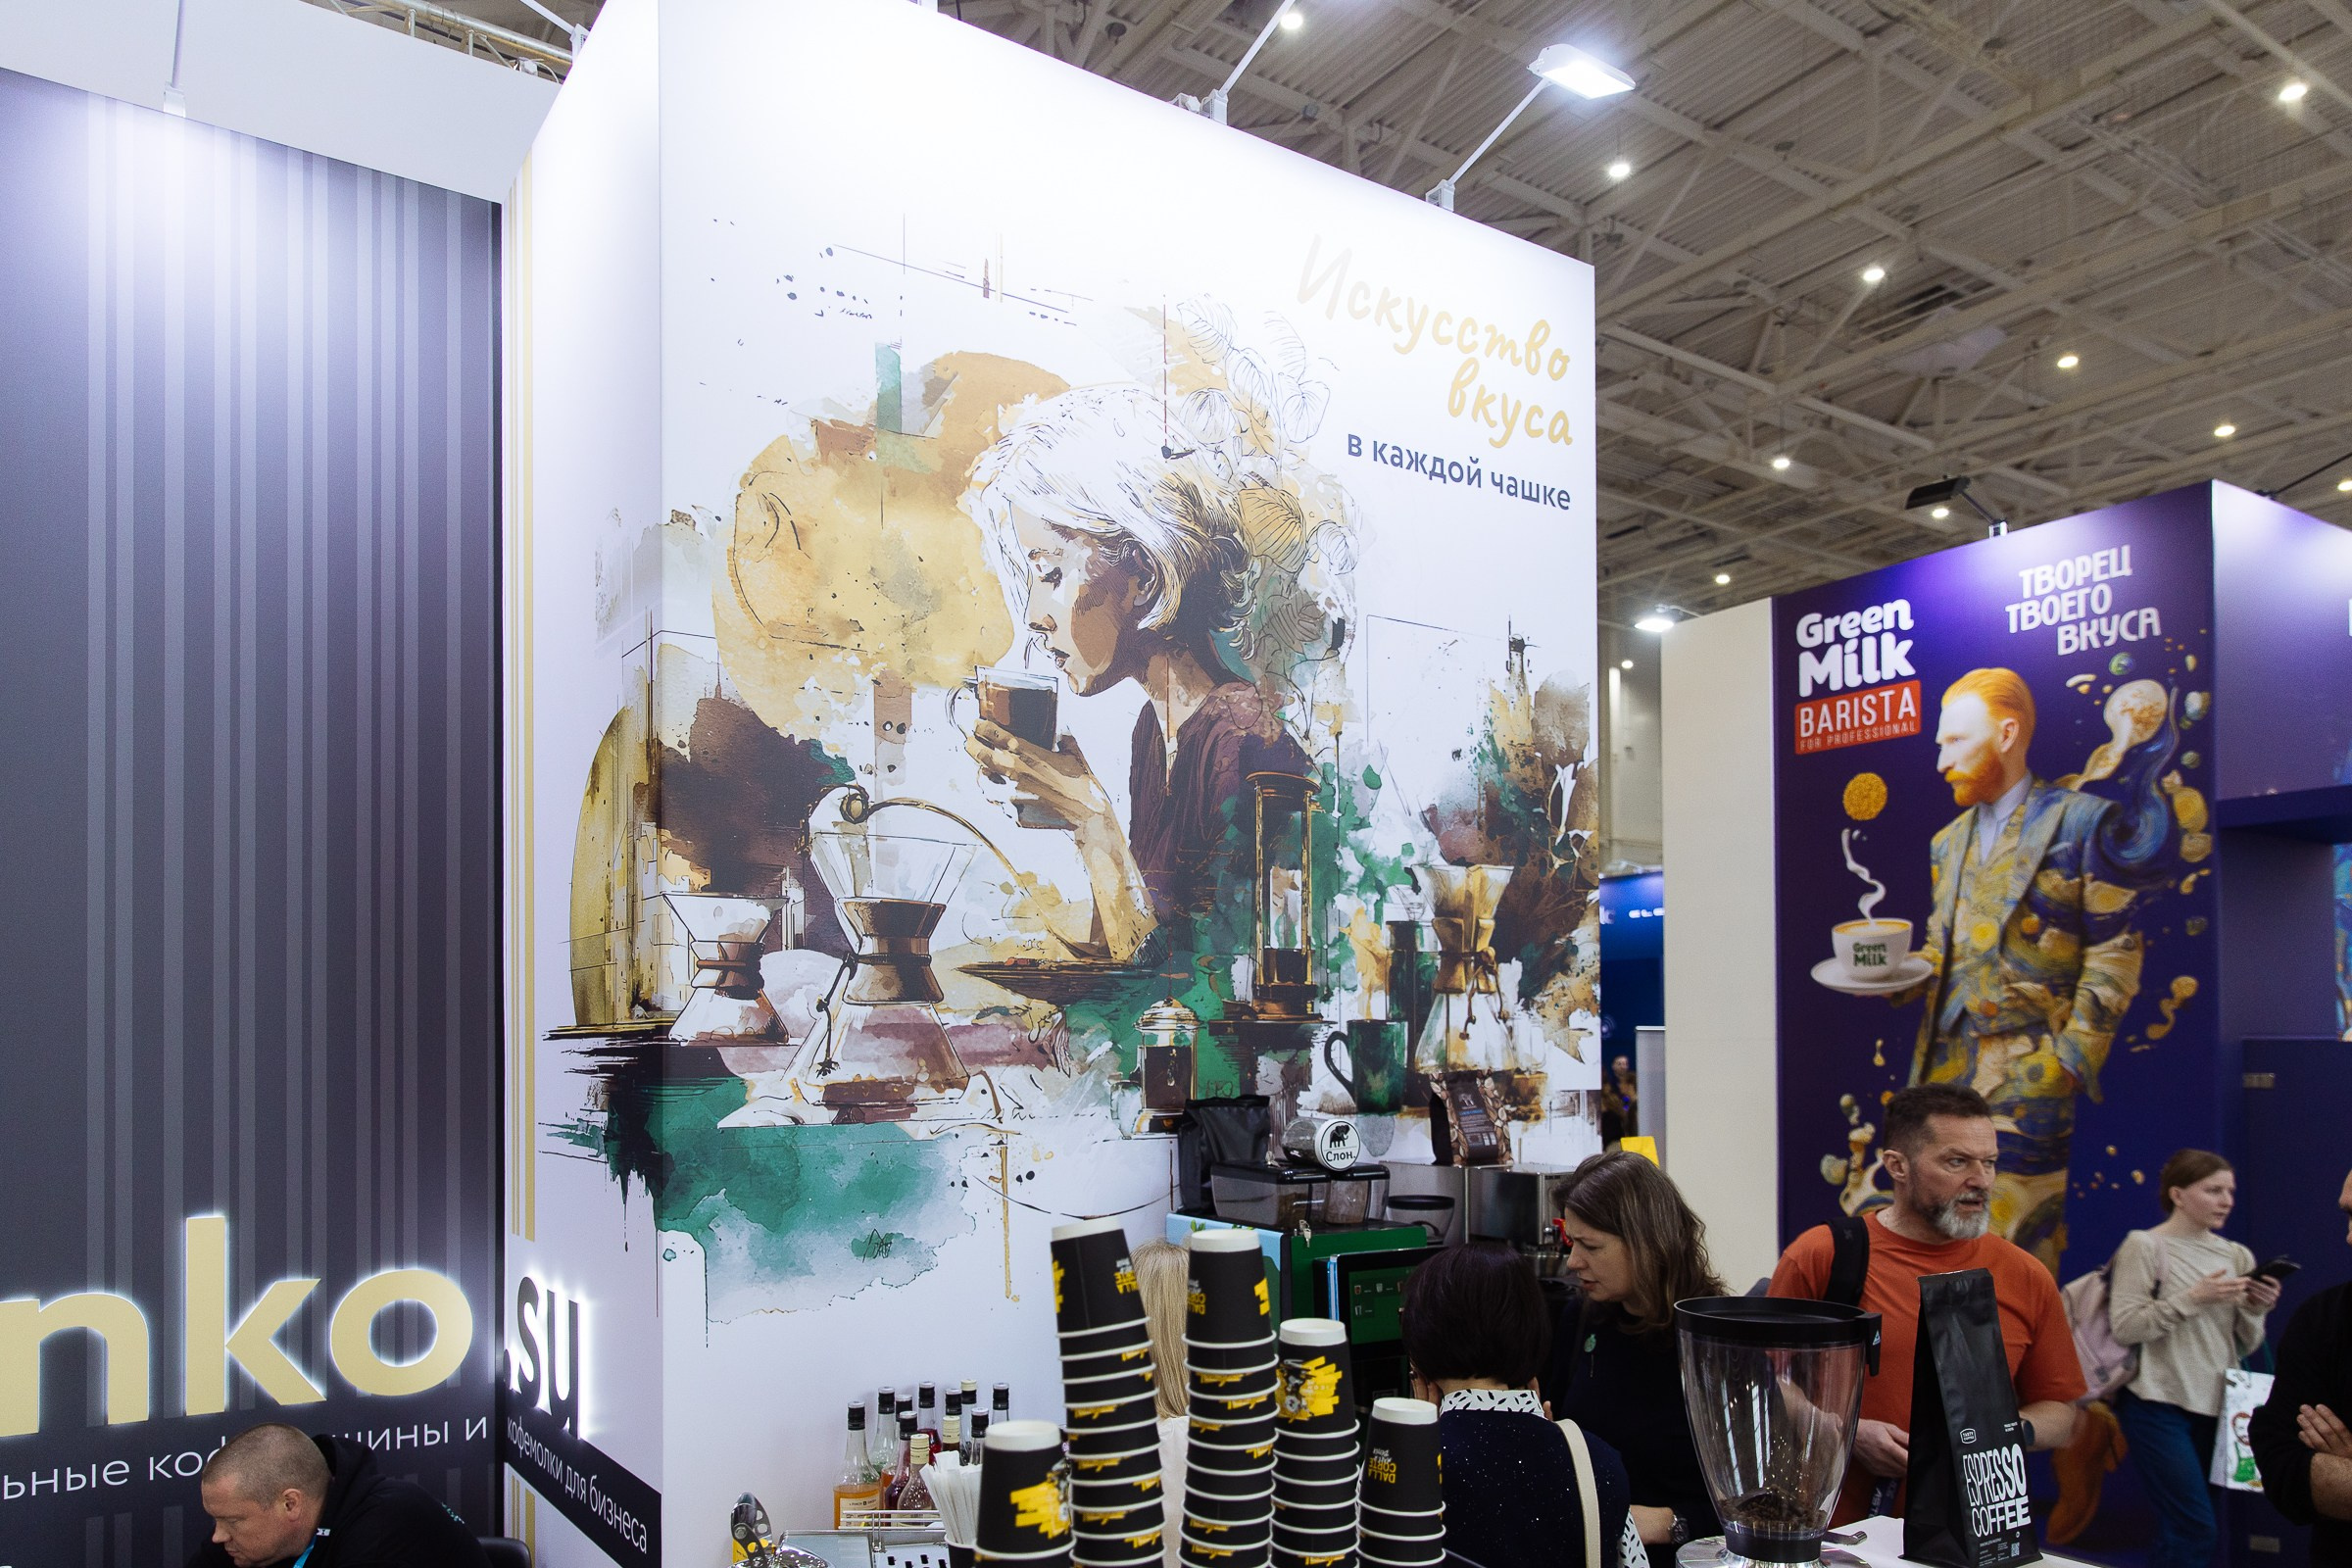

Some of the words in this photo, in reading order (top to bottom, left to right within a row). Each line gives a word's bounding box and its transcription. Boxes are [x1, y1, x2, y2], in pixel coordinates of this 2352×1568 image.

[1297, 233, 1571, 381] Искусство
[1447, 357, 1574, 449] вкуса
[1348, 433, 1362, 457] в
[1373, 439, 1482, 488] каждой
[1491, 471, 1571, 511] чашке
[2019, 544, 2132, 599] ТВОРЕЦ
[1795, 597, 1914, 650] Green
[2005, 582, 2113, 634] ТВОЕГО
[2056, 607, 2162, 657] ВКУСА
[1798, 631, 1916, 698] Milk
[1800, 687, 1917, 738] BARISTA
[1800, 737, 1822, 752] FOR
[1827, 720, 1916, 747] PROFESSIONAL
[1853, 953, 1886, 966] Milk
[1326, 1151, 1356, 1162] Слон.
[466, 1416, 487, 1442] и
[507, 1414, 563, 1485] кофемолки
[565, 1464, 587, 1504] для
[589, 1474, 648, 1554] бизнеса
[1368, 1469, 1396, 1484] DALLA
[1369, 1457, 1396, 1473] CORTE
[1963, 1443, 2028, 1507] ESPRESSO
[1971, 1494, 2032, 1538] COFFEE
